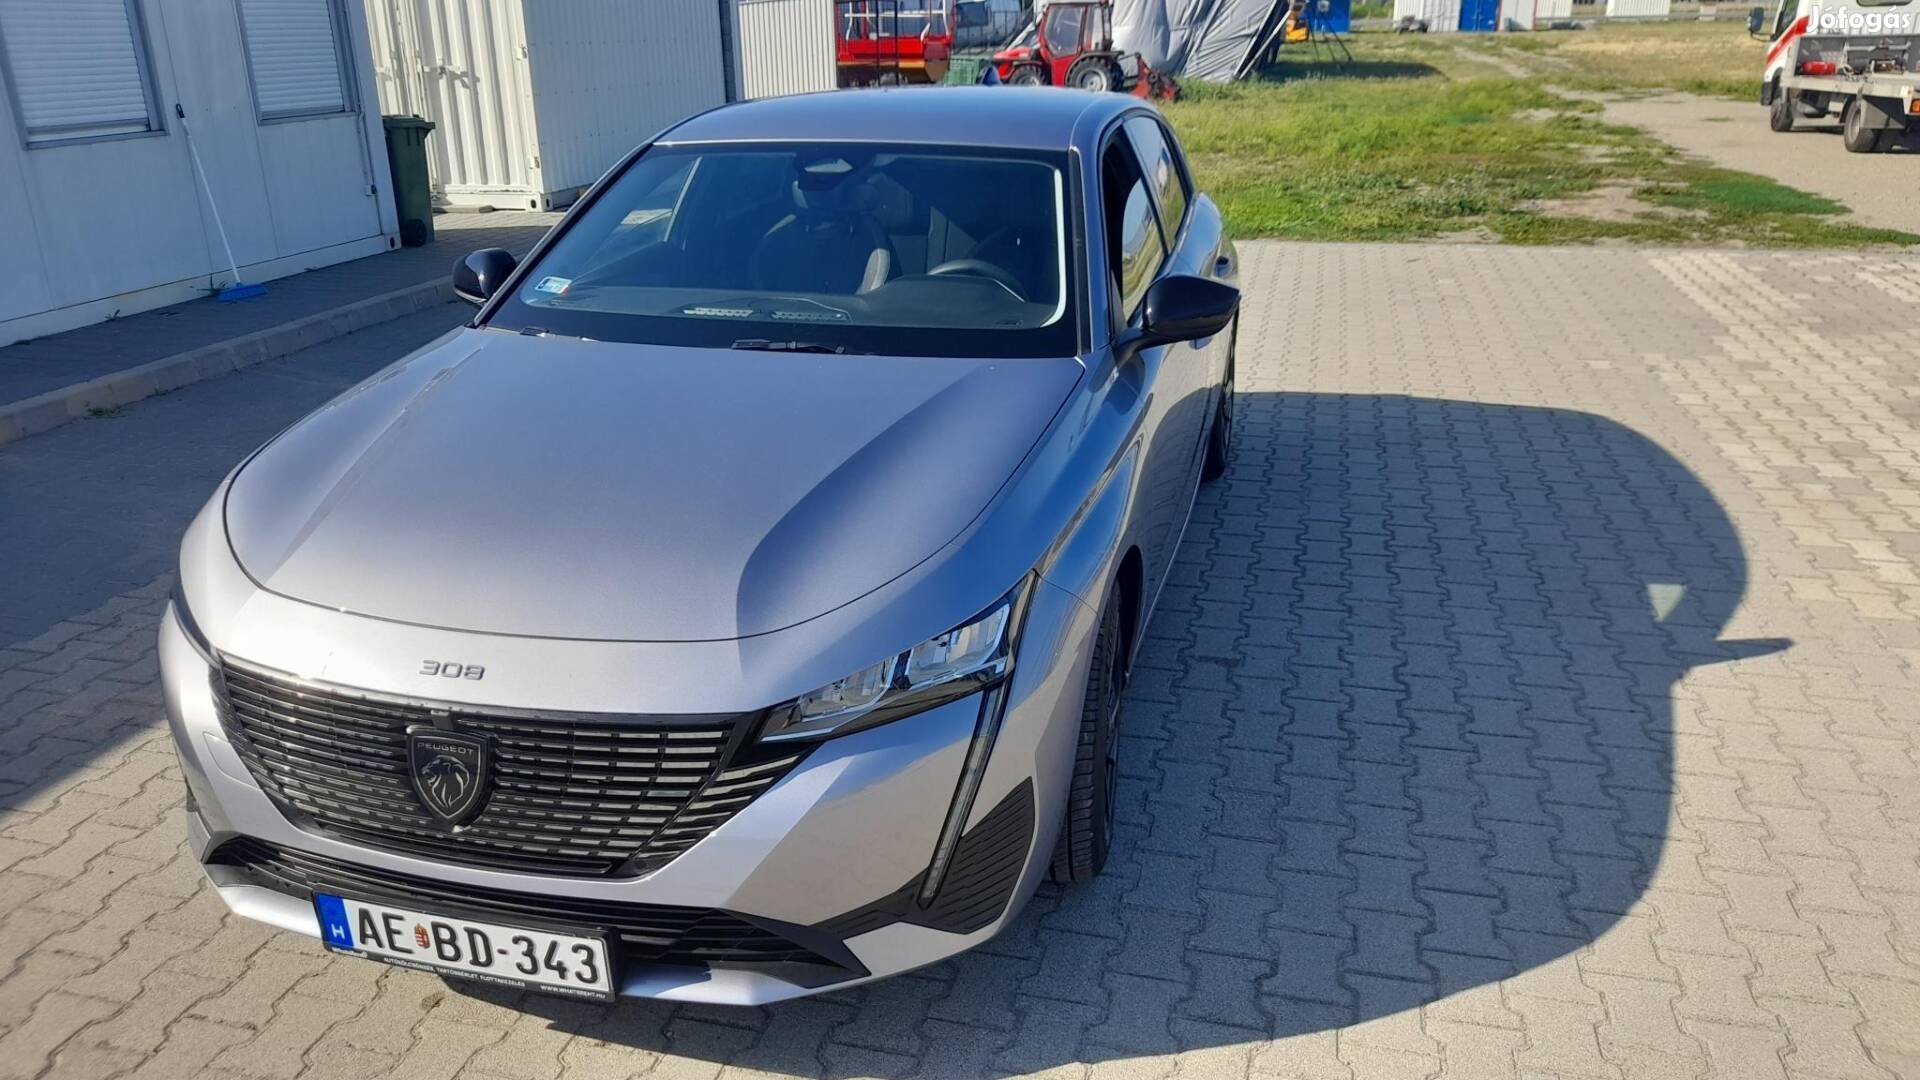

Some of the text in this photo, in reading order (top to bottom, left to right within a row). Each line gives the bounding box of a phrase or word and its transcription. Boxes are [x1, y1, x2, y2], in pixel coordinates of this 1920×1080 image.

[419, 660, 485, 680] 308
[417, 742, 474, 755] PEUGEOT
[331, 923, 345, 939] H
[358, 908, 599, 983] AE BD-343
